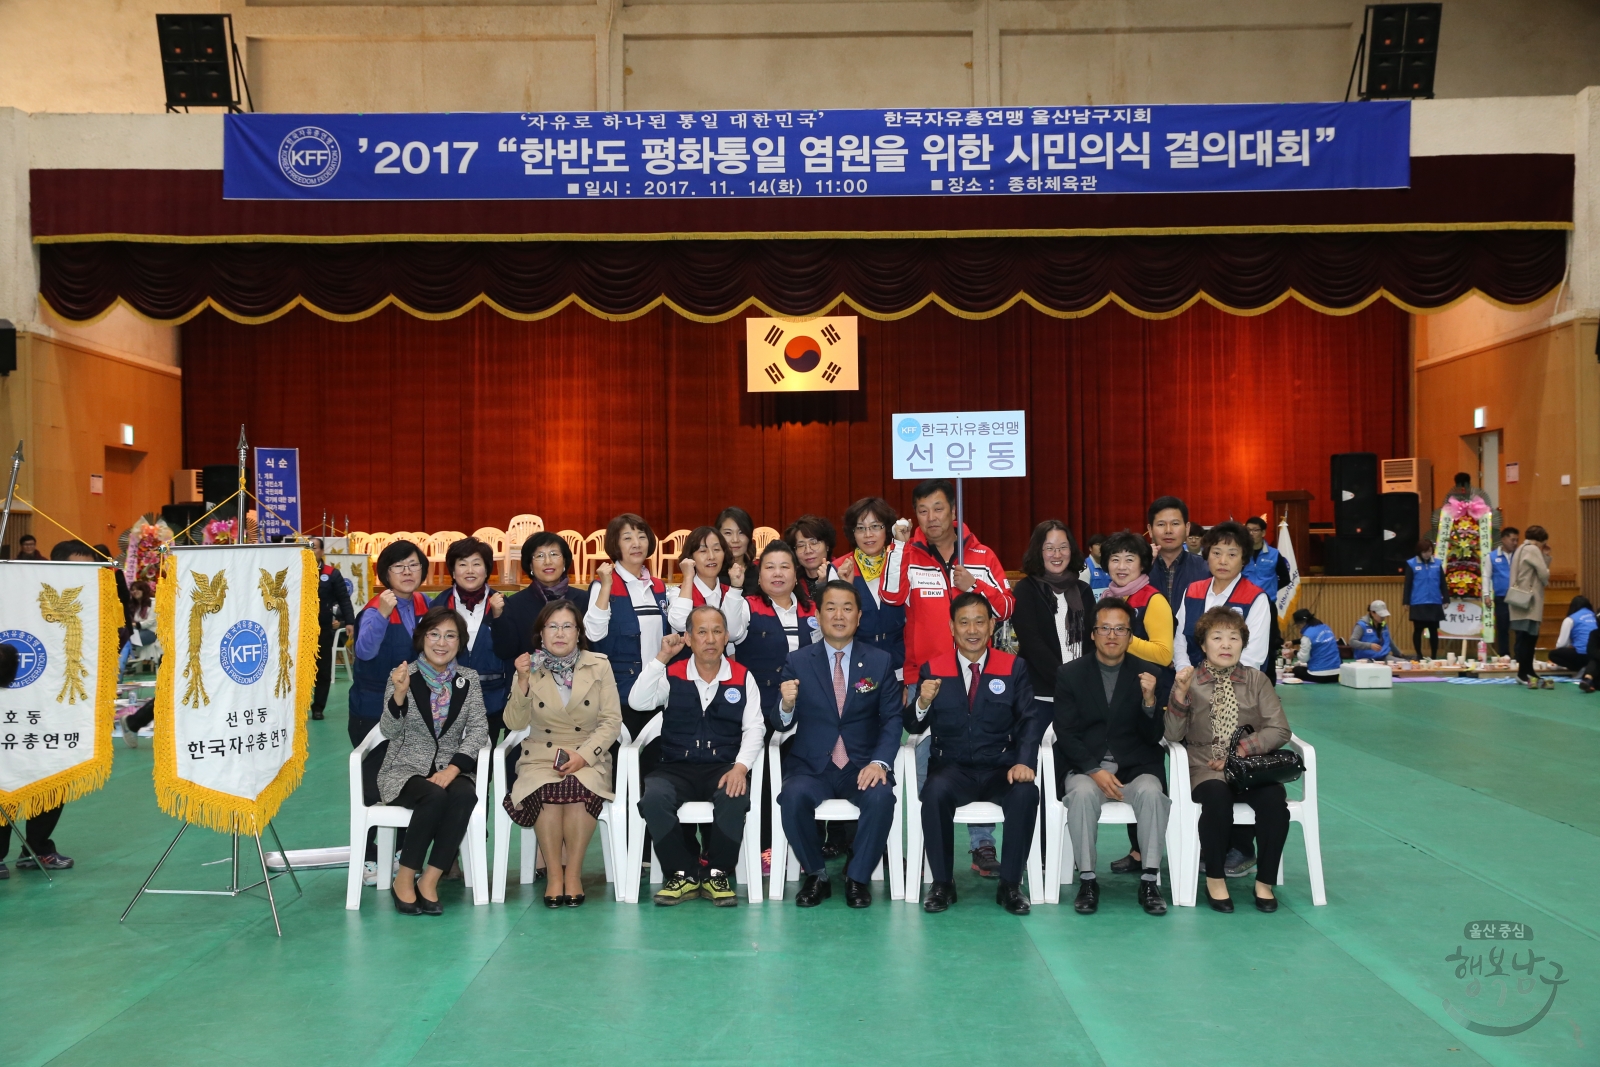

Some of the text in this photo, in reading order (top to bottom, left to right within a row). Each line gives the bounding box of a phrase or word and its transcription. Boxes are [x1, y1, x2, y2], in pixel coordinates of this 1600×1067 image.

[602, 113, 668, 130] 하나된
[676, 113, 719, 130] 통일
[883, 108, 1151, 127] 한국자유총연맹 울산남구지회
[291, 150, 329, 166] KFF
[641, 136, 787, 176] 평화통일
[799, 134, 909, 174] 염원을
[921, 133, 995, 172] 위한
[1005, 131, 1151, 171] 시민의식
[644, 180, 697, 195] 2017.
[709, 180, 735, 195] 11.
[748, 178, 803, 196] 14(화)
[815, 179, 868, 194] 11:00
[1007, 175, 1098, 192] 종하체육관
[901, 426, 918, 434] KFF
[921, 420, 1020, 437] 한국자유총연맹
[230, 643, 263, 664] KFF
[21, 651, 46, 687] FEDERATION
[220, 642, 268, 684] KOREA FREEDOM FEDERATION
[225, 707, 268, 728] 선암동
